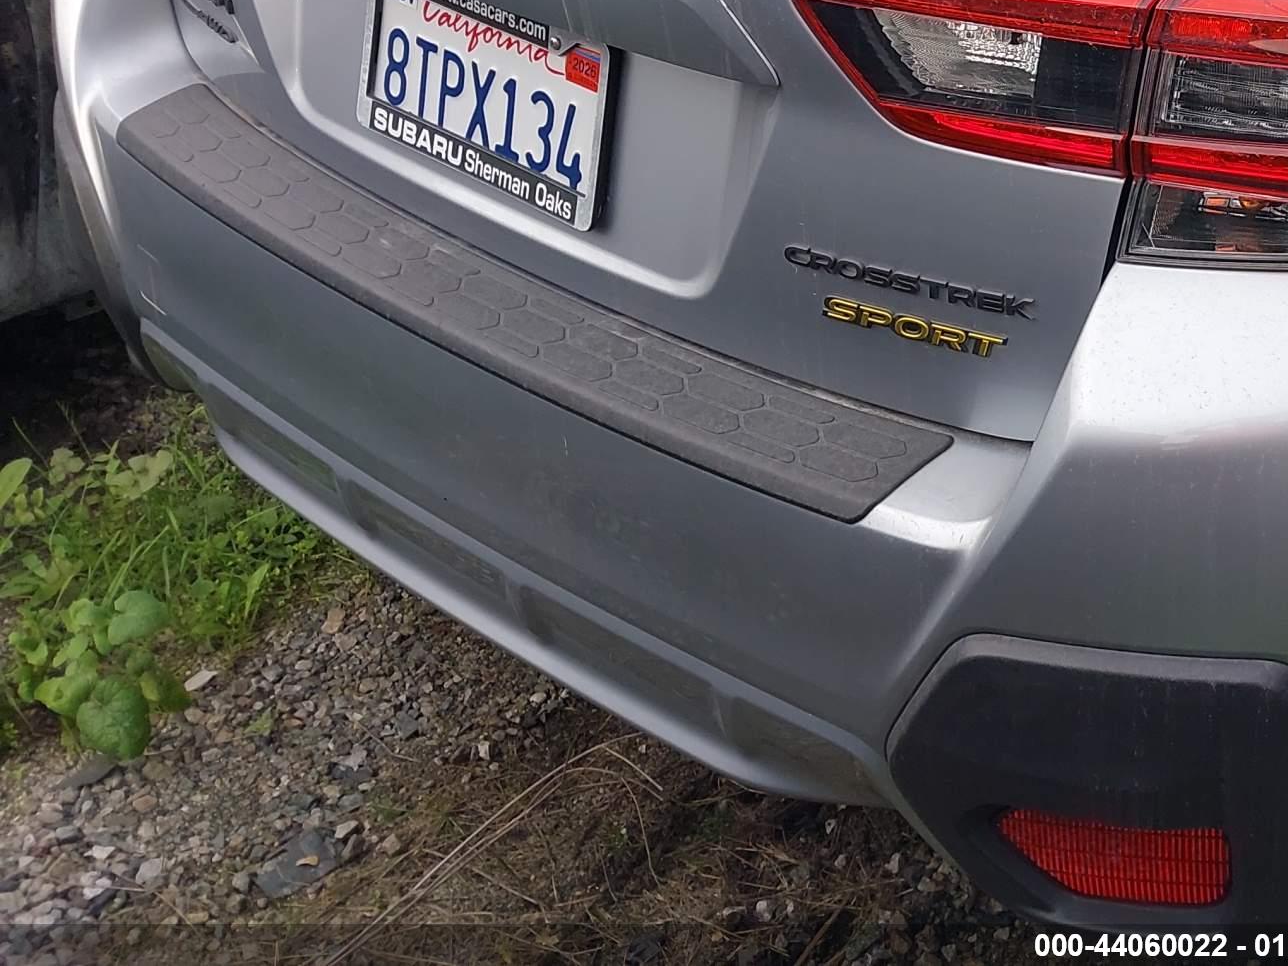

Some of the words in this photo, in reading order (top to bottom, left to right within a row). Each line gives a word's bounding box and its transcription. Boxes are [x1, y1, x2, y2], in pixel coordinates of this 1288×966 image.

[572, 57, 597, 78] 2026
[383, 28, 582, 191] 8TPX134
[373, 107, 463, 166] SUBARU
[464, 149, 529, 200] Sherman
[534, 182, 572, 220] Oaks
[784, 243, 1036, 321] CROSSTREK
[822, 295, 1008, 358] SPORT
